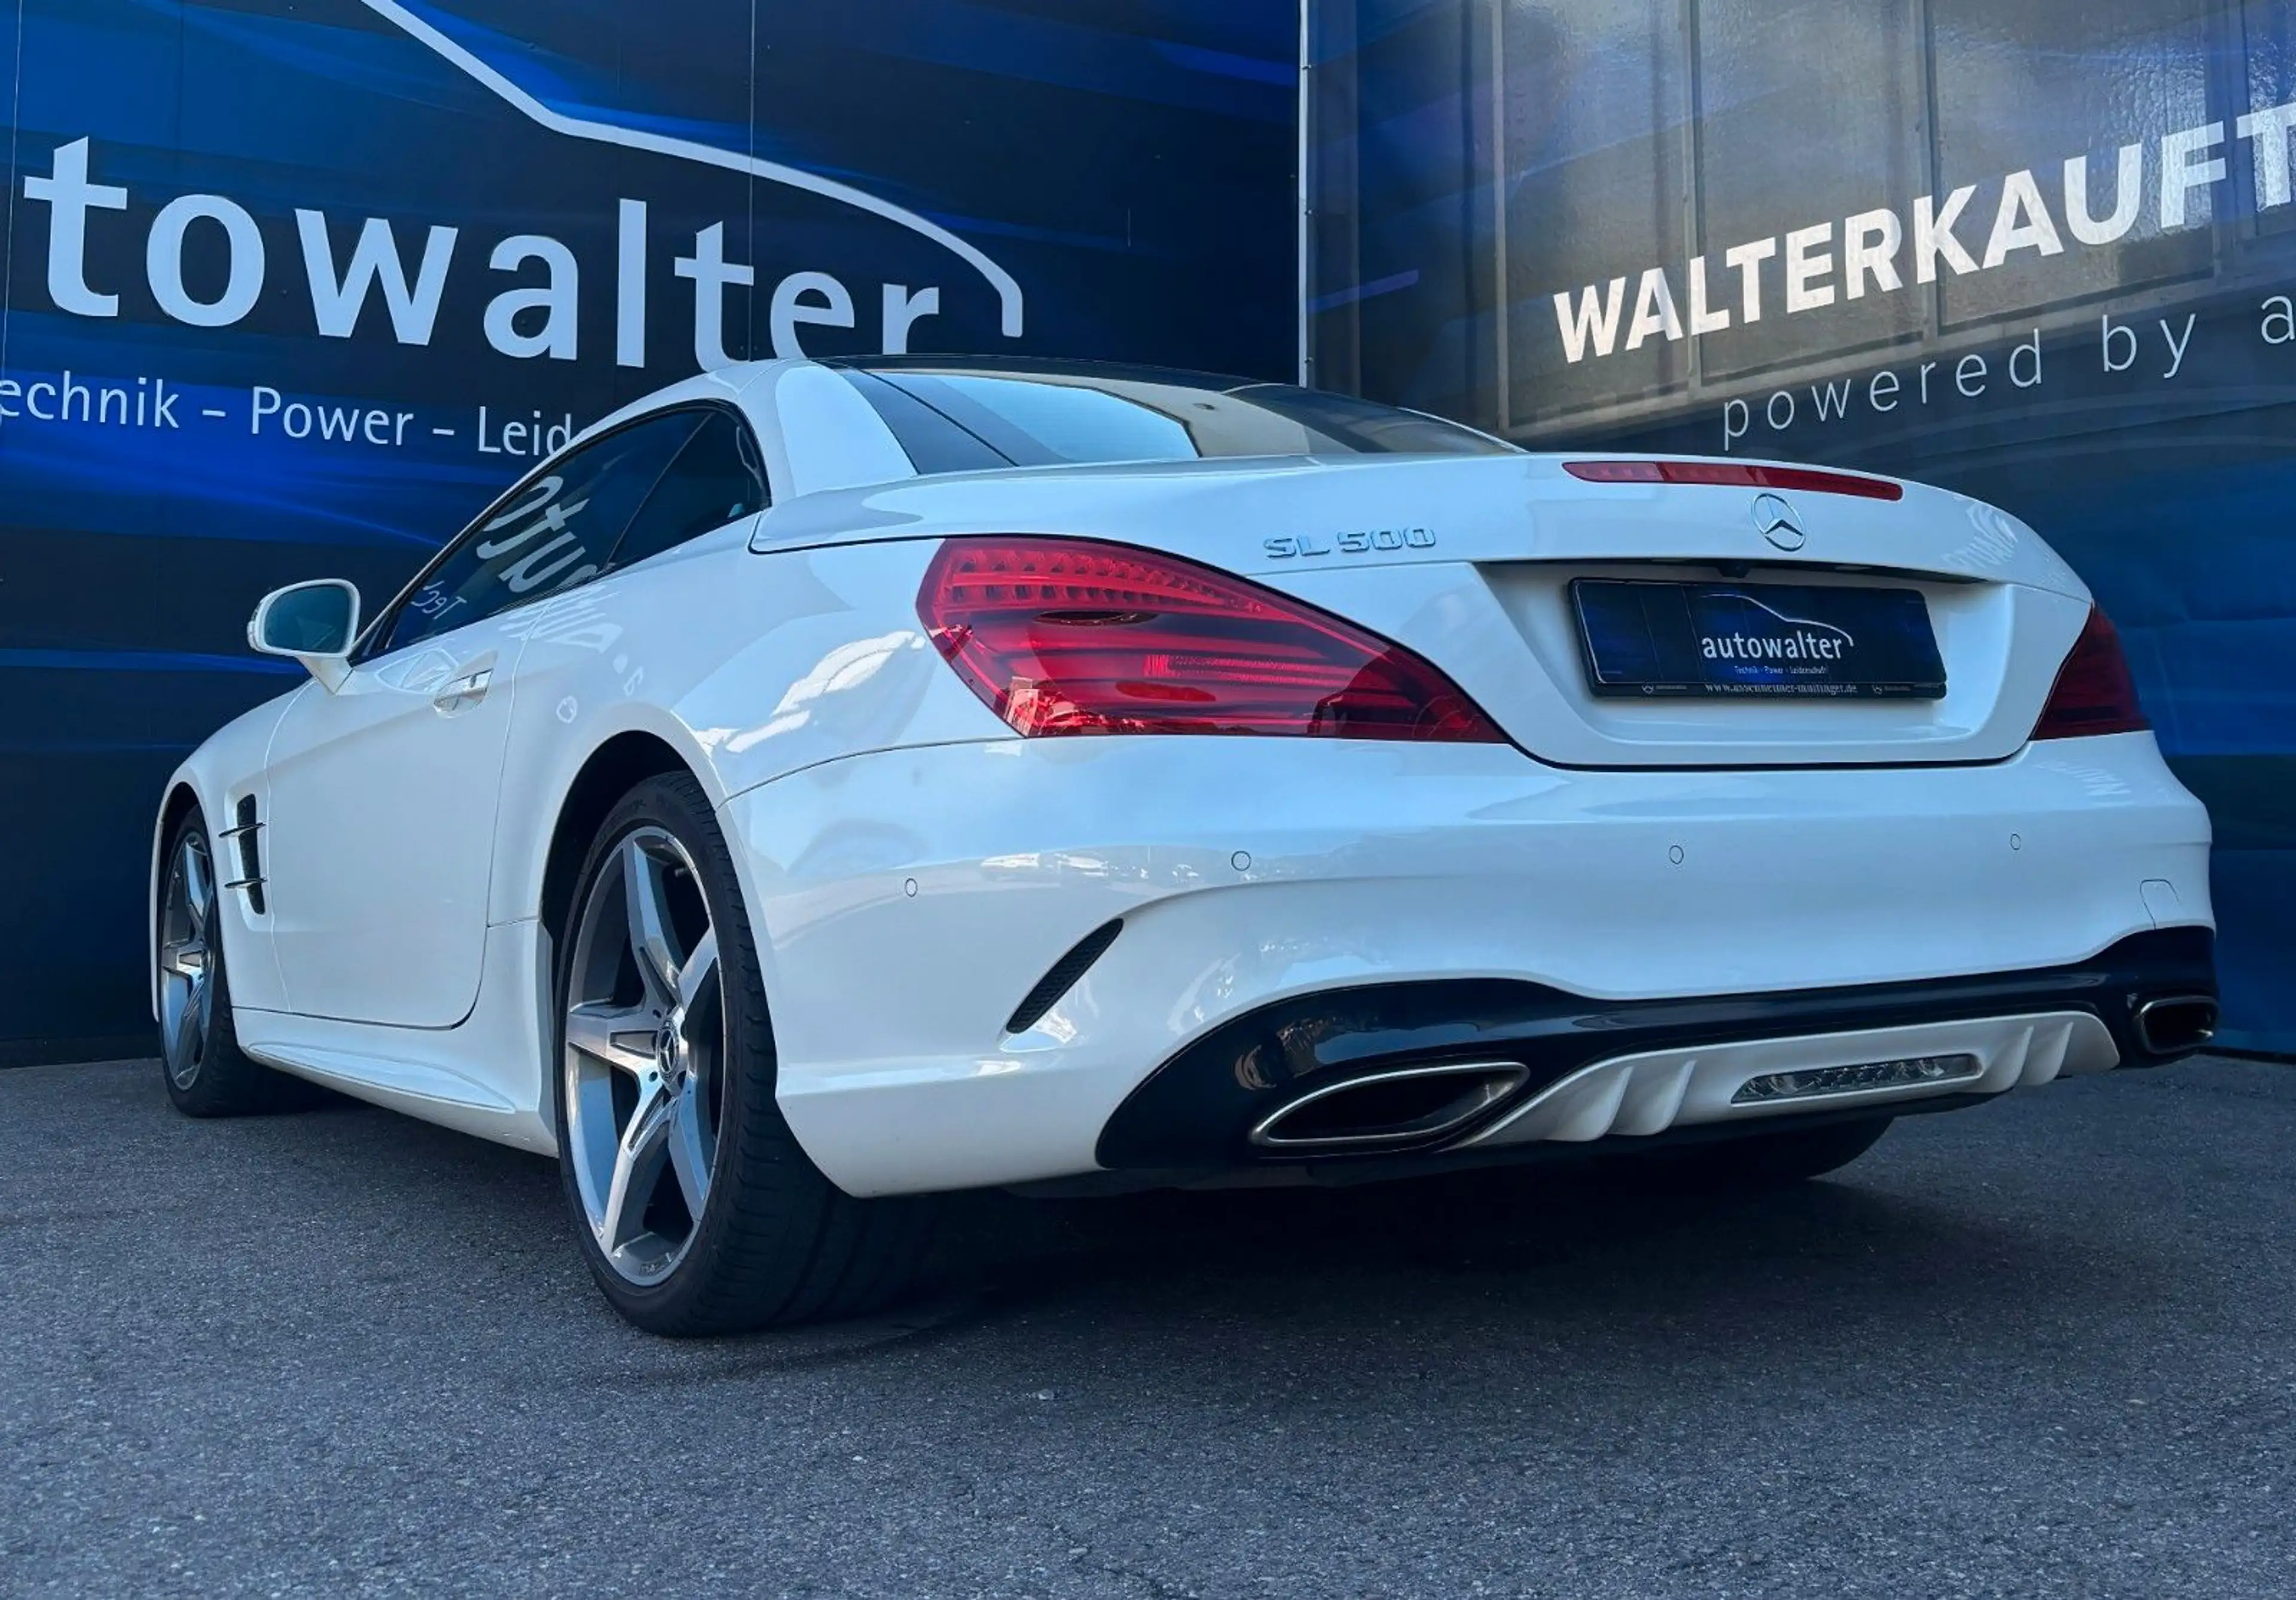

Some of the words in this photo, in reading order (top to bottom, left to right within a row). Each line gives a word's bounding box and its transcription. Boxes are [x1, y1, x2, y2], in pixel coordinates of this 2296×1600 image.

[23, 136, 939, 372] towalter
[1553, 103, 2296, 364] WALTERKAUFT
[0, 370, 179, 429] echnik
[251, 386, 414, 447] Power
[1723, 328, 2042, 451] powered
[2102, 313, 2196, 379] by
[1262, 535, 1330, 558] SL
[1337, 527, 1436, 553] 500
[1702, 630, 1842, 659] autowalter
